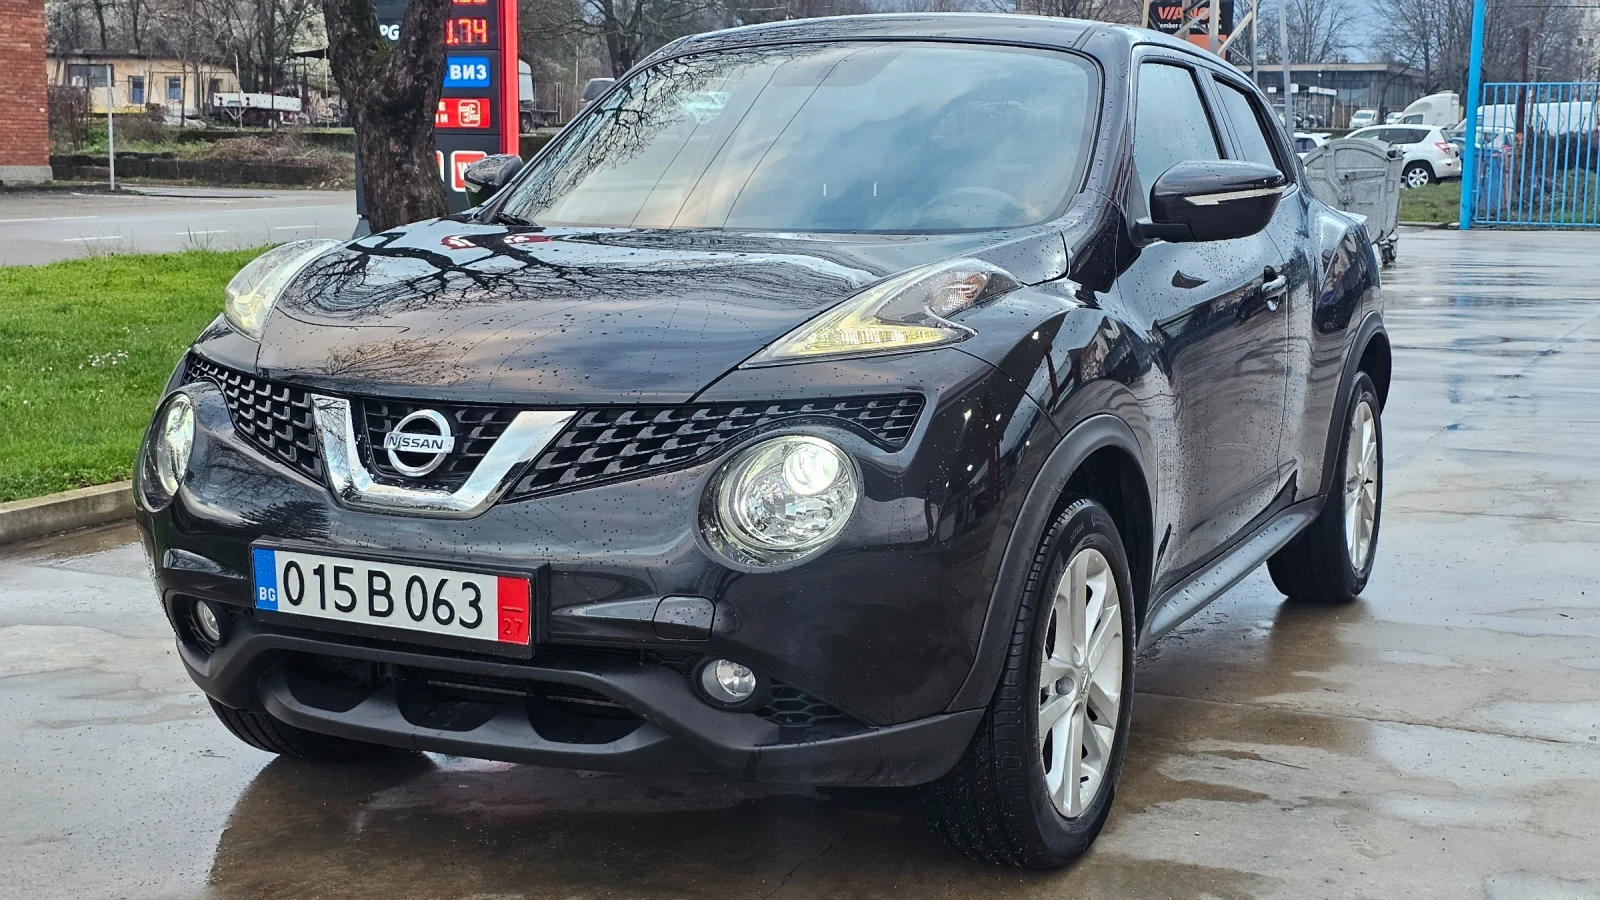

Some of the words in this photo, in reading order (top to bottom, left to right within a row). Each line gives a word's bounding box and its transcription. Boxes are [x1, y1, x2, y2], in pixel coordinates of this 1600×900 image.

[445, 18, 487, 44] 1.74
[388, 436, 444, 450] NISSAN
[259, 586, 276, 601] BG
[502, 617, 524, 639] 27
